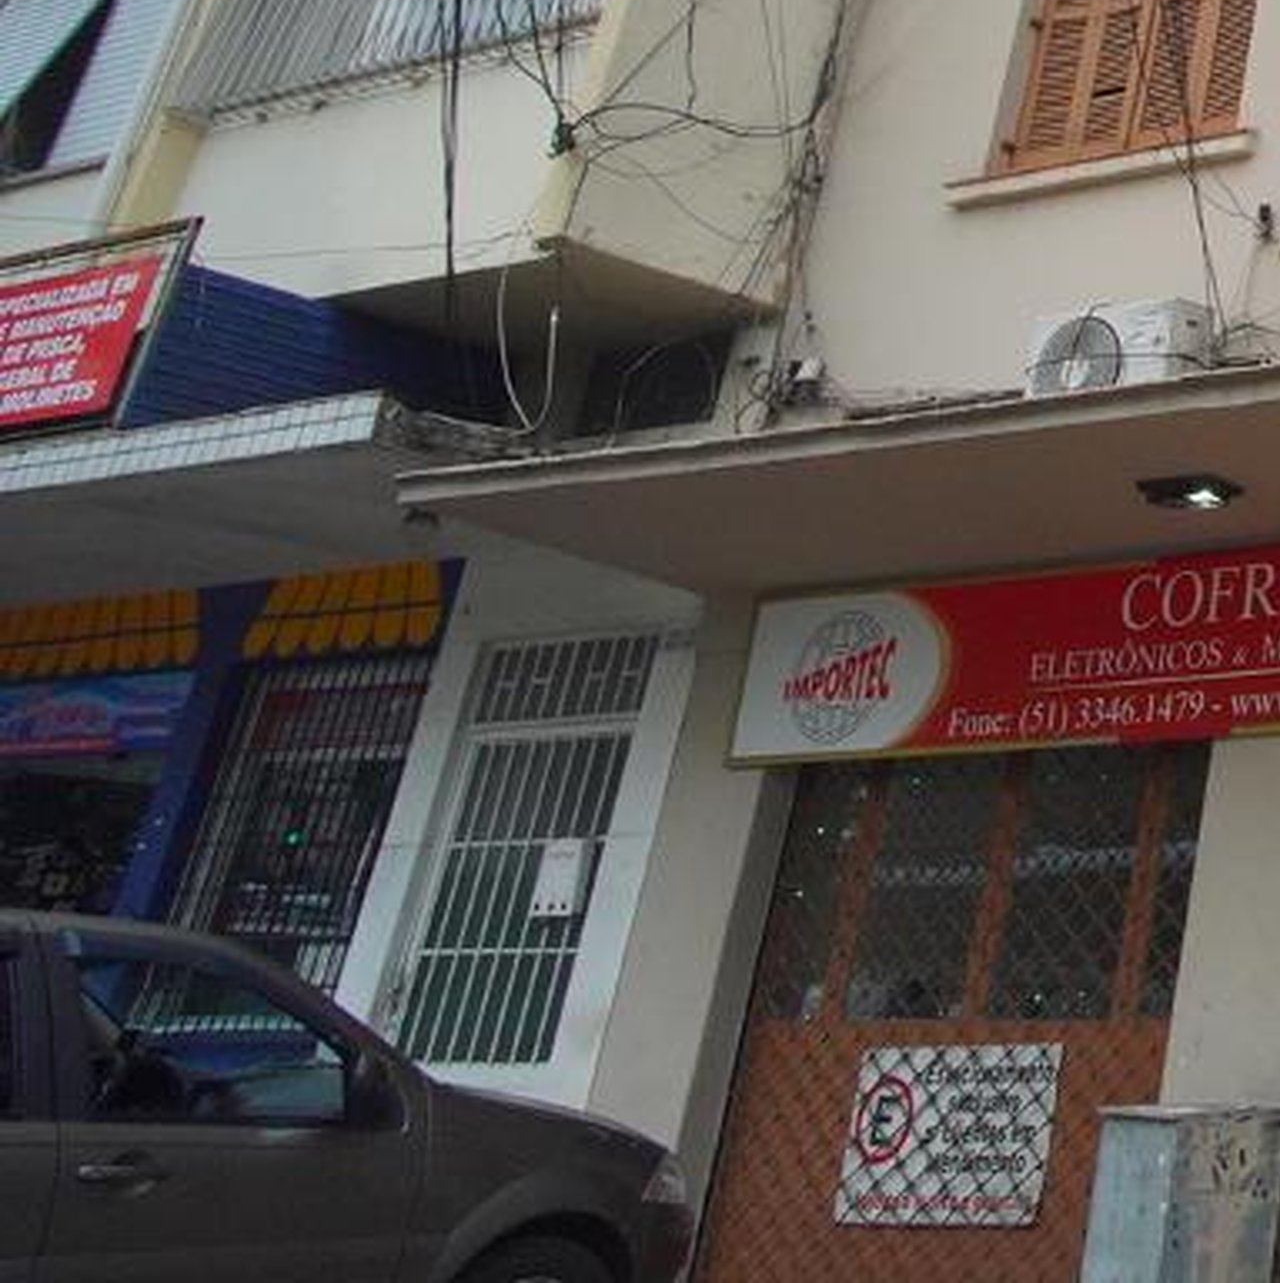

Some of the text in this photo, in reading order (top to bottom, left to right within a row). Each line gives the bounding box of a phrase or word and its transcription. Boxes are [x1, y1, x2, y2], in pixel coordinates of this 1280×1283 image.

[783, 637, 897, 704] IMPORTEC
[1030, 637, 1224, 683] ELETRÔNICOS
[1018, 696, 1069, 737] (51)
[1075, 688, 1205, 730] 3346.1479
